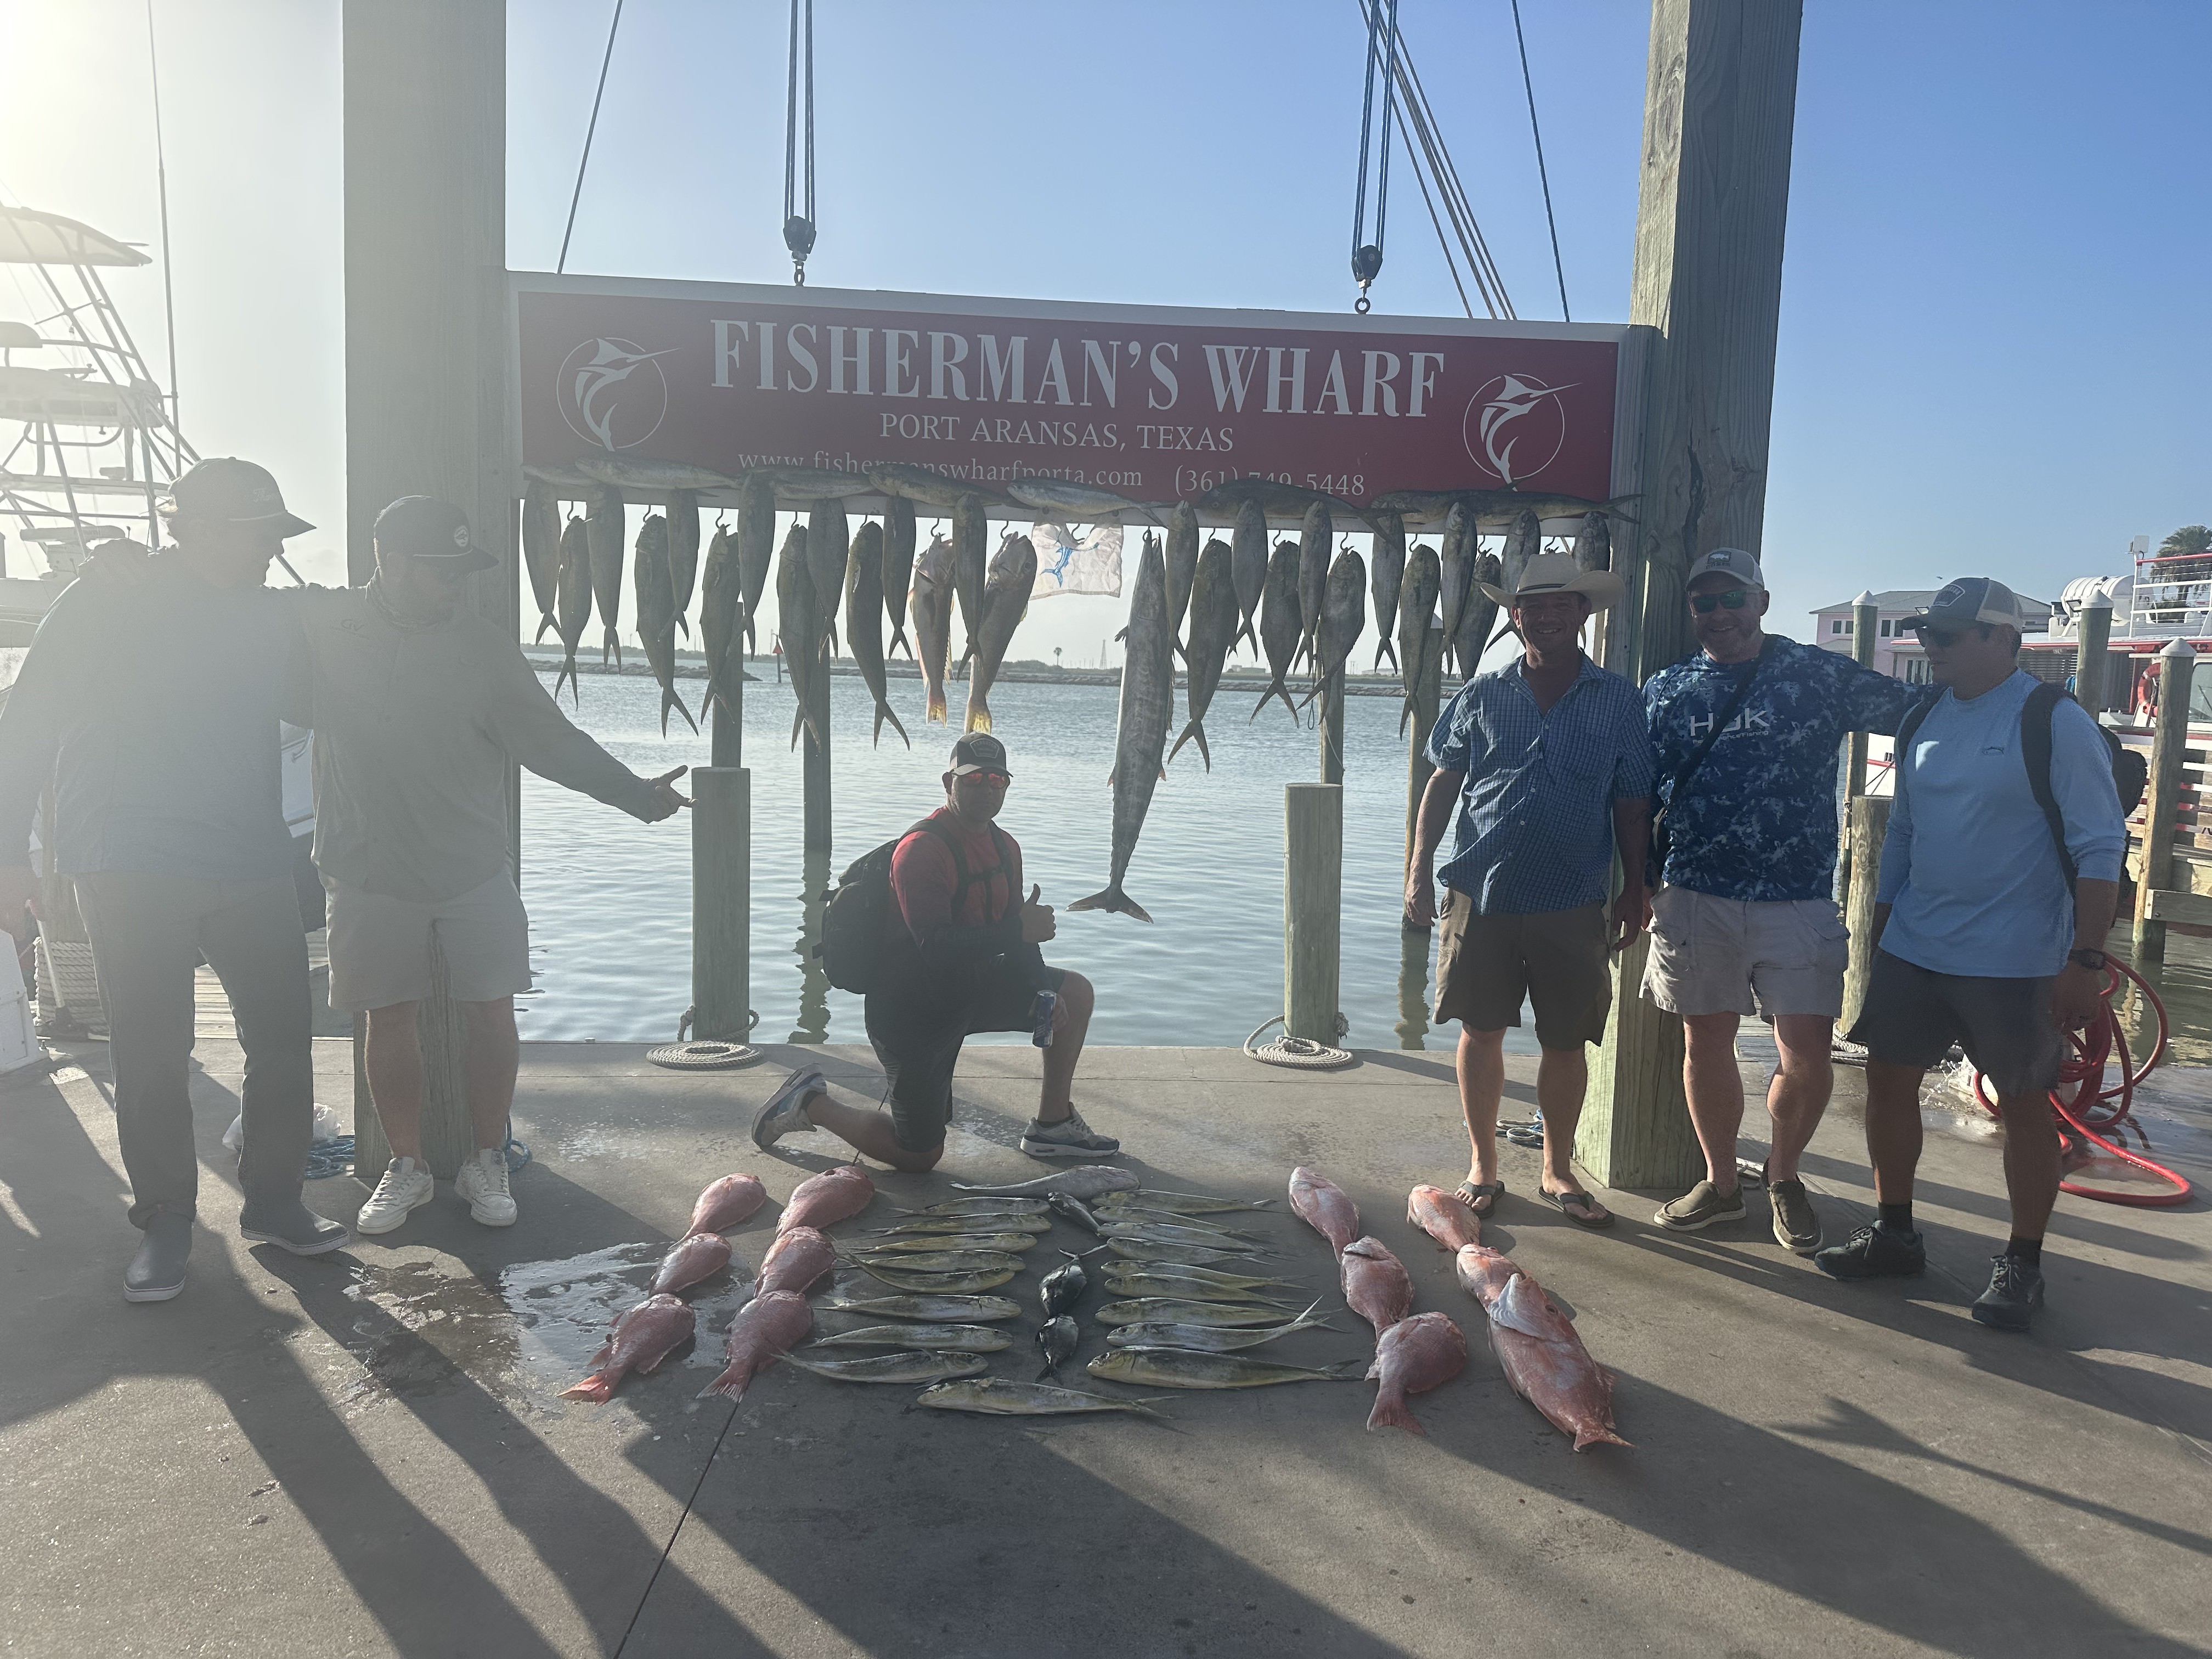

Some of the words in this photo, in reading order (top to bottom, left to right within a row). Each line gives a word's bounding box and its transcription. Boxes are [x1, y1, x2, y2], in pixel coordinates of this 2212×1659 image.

[1202, 345, 1444, 417] WHARF
[879, 413, 960, 440] PORT
[970, 417, 1126, 452] ARANSAS,
[1136, 425, 1233, 452] TEXAS
[738, 450, 1142, 486] wwwfishenswharforta.com
